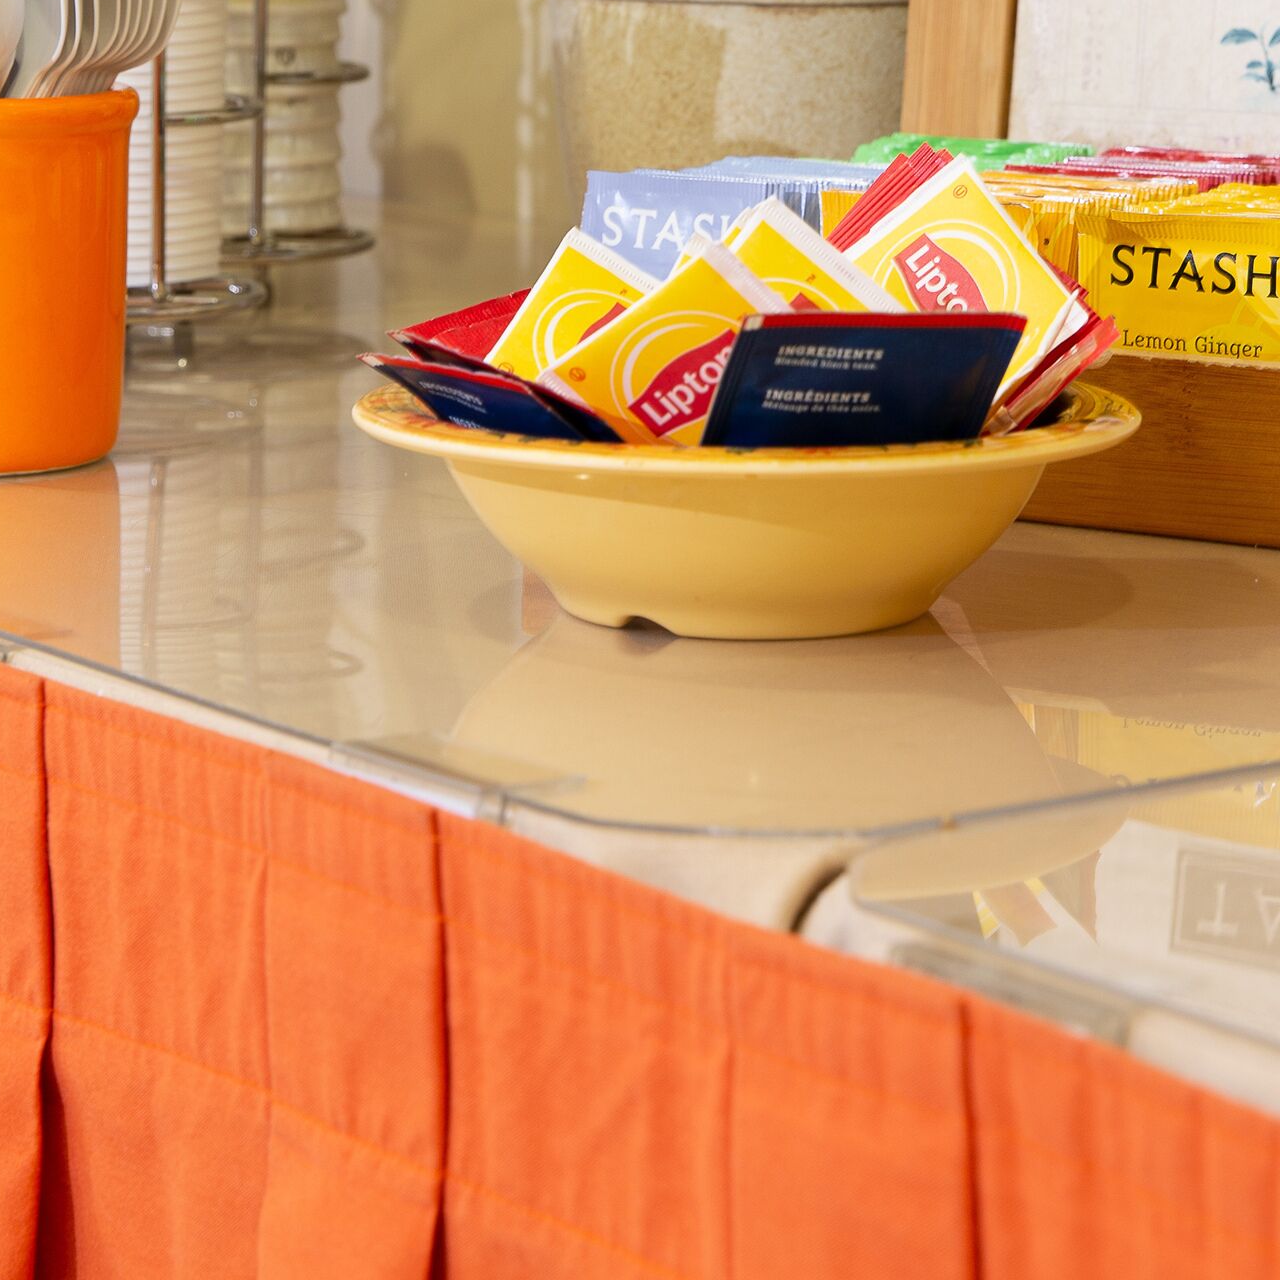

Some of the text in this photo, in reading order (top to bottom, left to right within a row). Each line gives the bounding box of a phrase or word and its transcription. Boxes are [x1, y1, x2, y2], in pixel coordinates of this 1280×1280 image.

[601, 205, 735, 252] STAS
[905, 244, 968, 312] Lipto
[1110, 244, 1280, 299] STASH
[778, 345, 884, 361] INGREDIENTS
[1122, 329, 1263, 360] Lemon Ginger
[765, 389, 871, 403] INGRÉDIENTS
